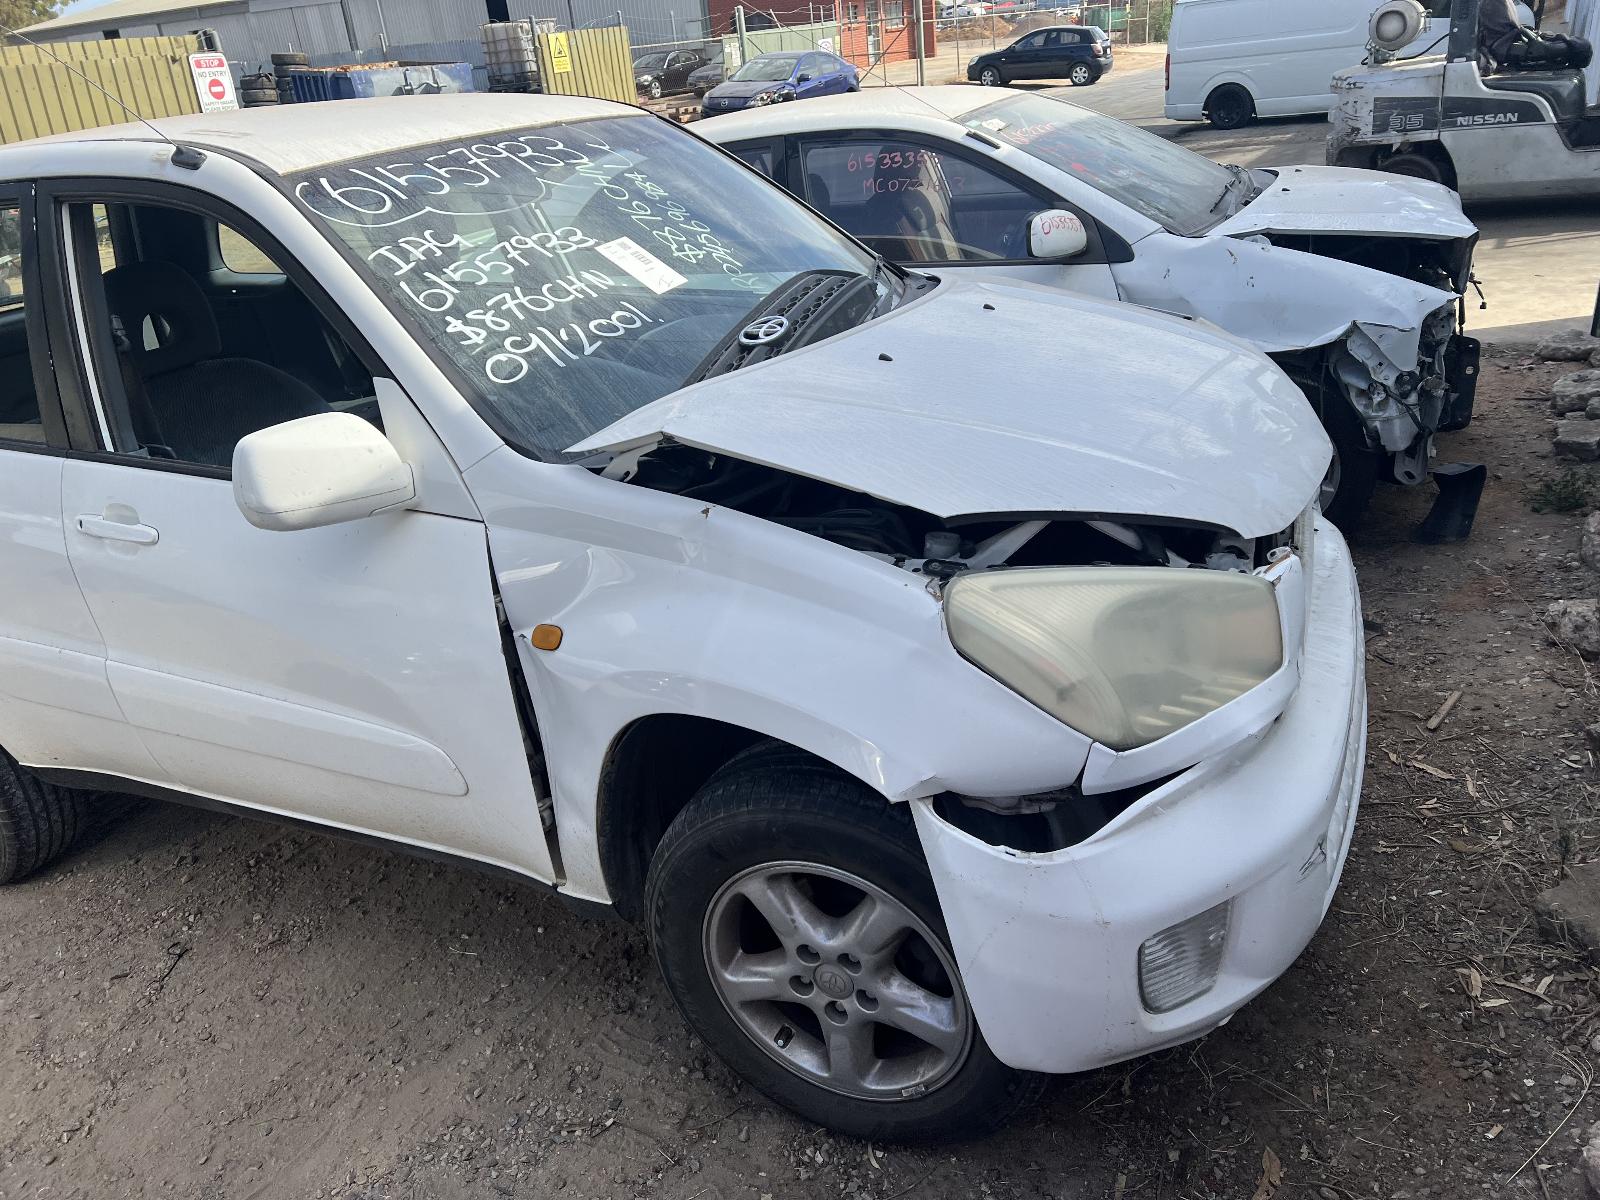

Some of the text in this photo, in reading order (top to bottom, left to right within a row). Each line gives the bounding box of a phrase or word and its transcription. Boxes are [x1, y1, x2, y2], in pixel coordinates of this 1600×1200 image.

[200, 59, 220, 68] STOP
[208, 70, 227, 78] ENTRY
[1389, 113, 1424, 130] 35
[1456, 112, 1519, 126] NISSAN
[319, 136, 590, 214] 61557933
[399, 226, 599, 312] 61557933
